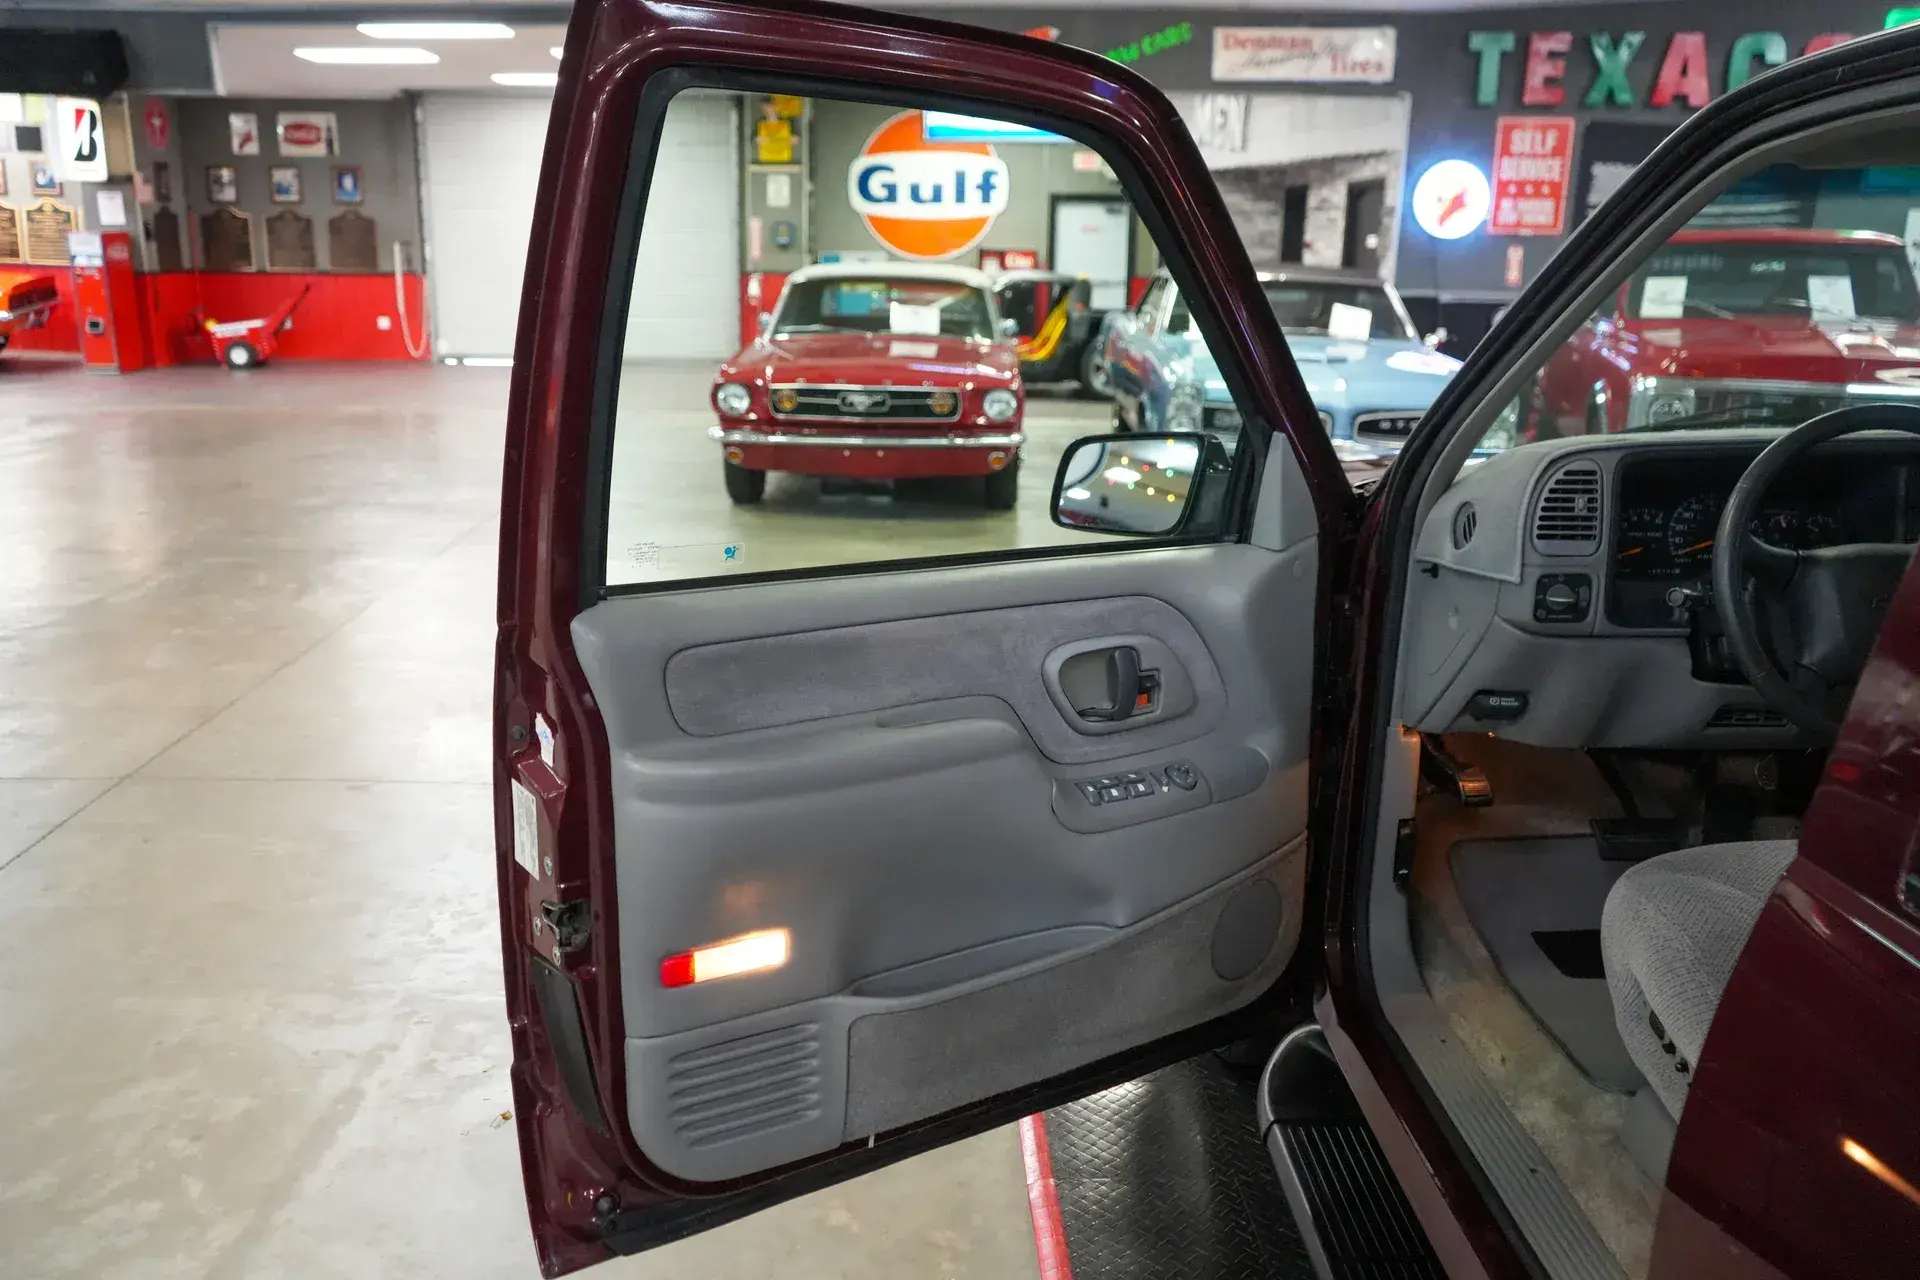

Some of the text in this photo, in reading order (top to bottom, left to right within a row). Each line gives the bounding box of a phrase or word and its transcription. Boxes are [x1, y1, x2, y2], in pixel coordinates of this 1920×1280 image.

[1468, 31, 1857, 107] TEXAC
[1509, 128, 1560, 154] SELF
[858, 165, 998, 203] Gulf
[1499, 155, 1563, 182] SERVICE
